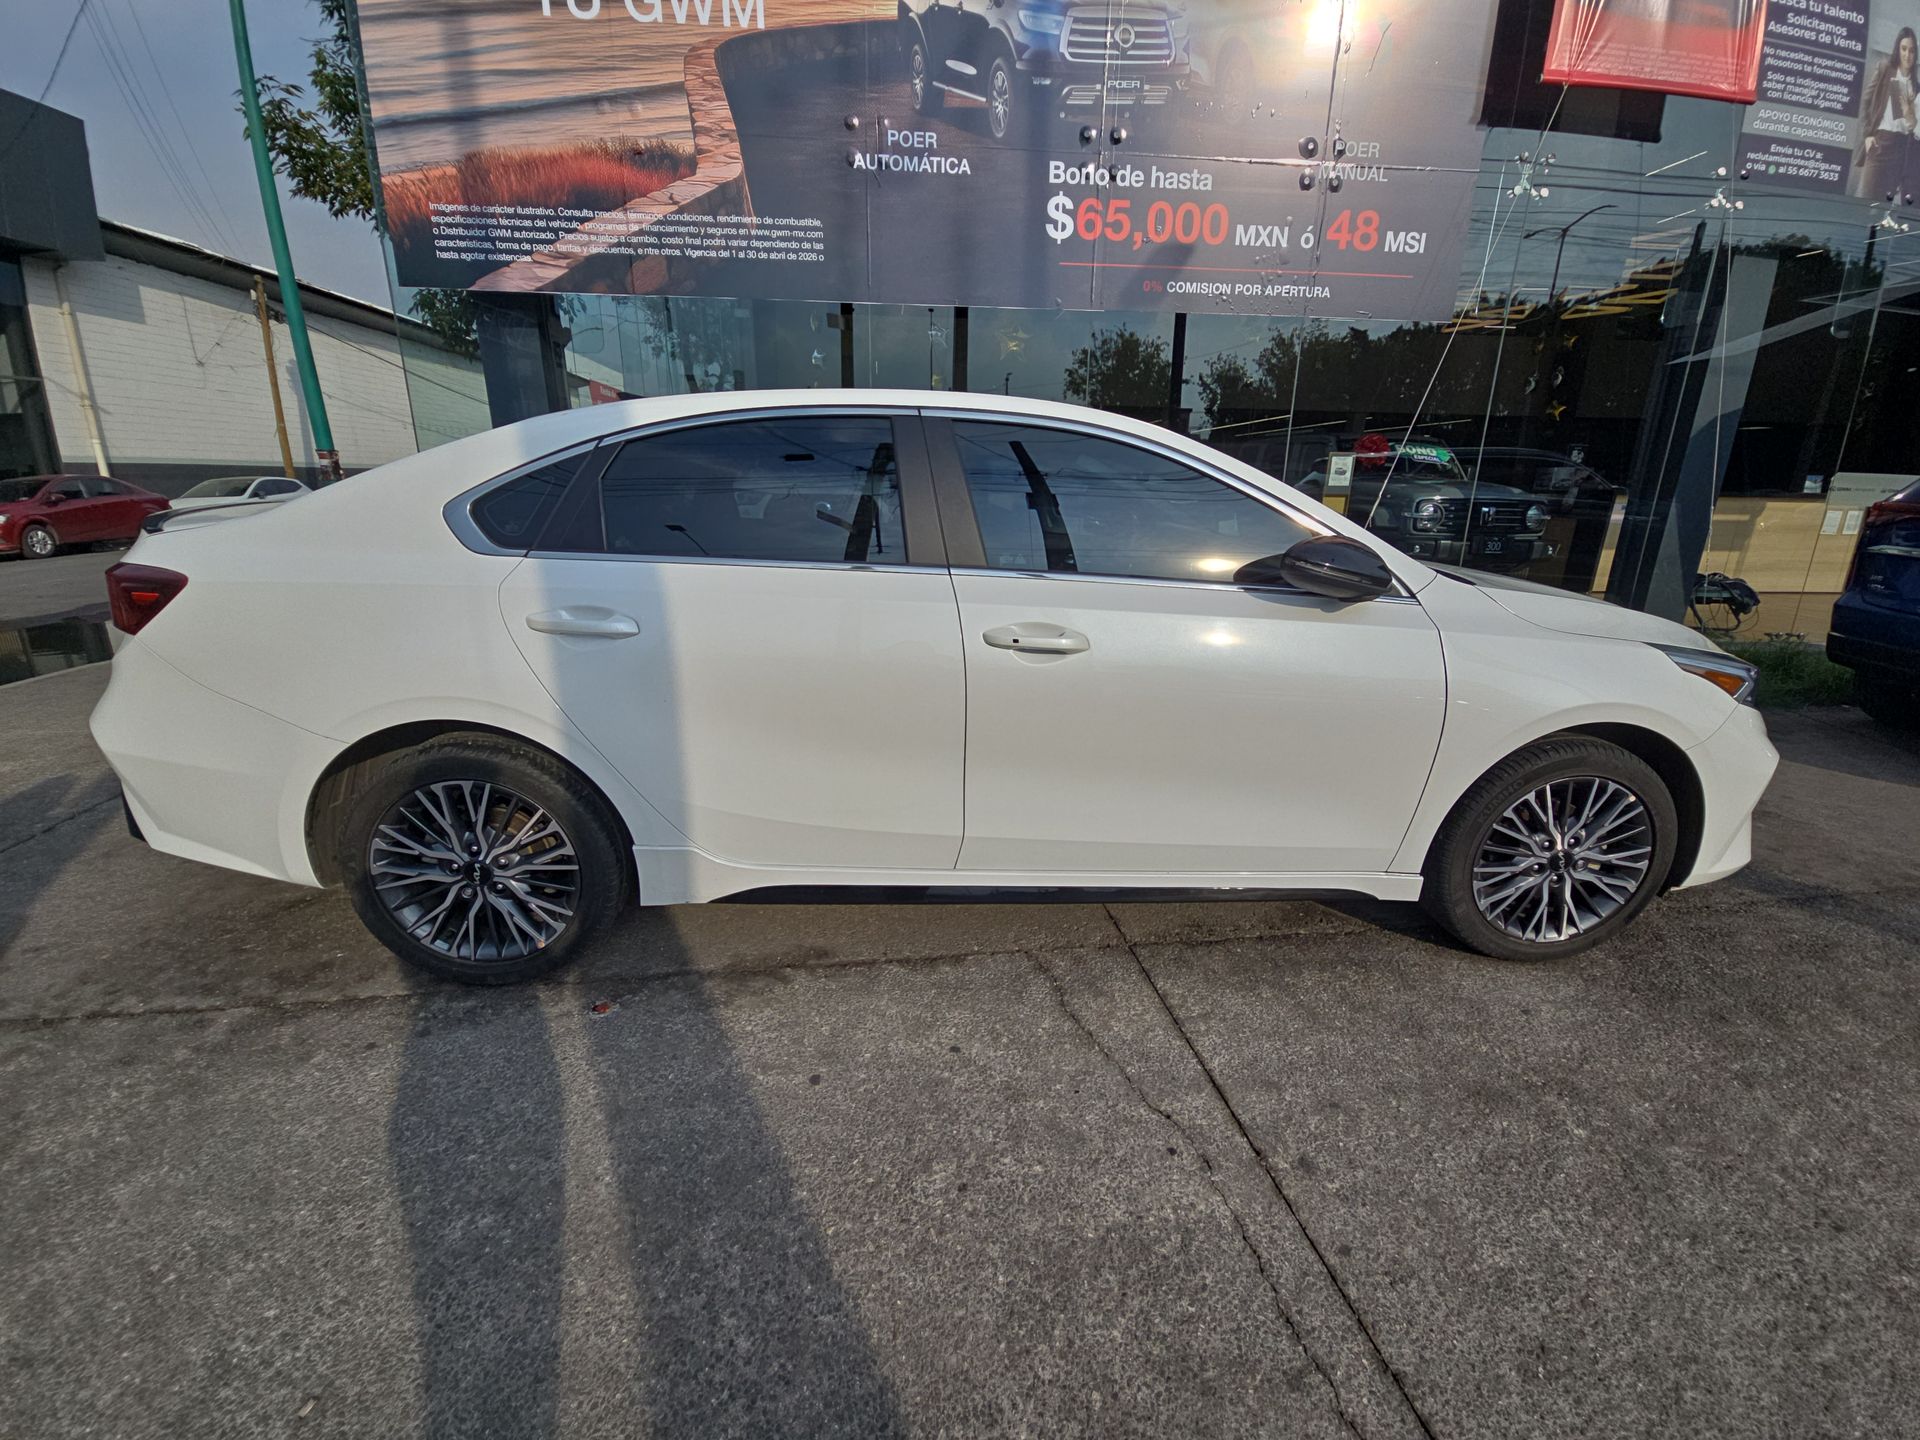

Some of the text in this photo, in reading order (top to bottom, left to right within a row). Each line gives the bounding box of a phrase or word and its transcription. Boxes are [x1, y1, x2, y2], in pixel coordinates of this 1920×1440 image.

[1787, 12, 1847, 36] Solicitamos
[1824, 3, 1864, 24] talento
[1768, 21, 1862, 51] Asesores de Venta
[1763, 46, 1774, 55] No
[1776, 49, 1812, 62] necesitas
[1767, 71, 1848, 94] Solo es indispensable
[1804, 64, 1812, 72] te
[1813, 65, 1854, 81] formamos!
[1762, 80, 1850, 103] saber manejar y contar
[1767, 90, 1782, 98] con
[1783, 90, 1812, 104] licencia
[1753, 120, 1846, 142] durante capacitación
[1758, 109, 1845, 131] APOYO ECONÓMICO
[887, 129, 937, 148] POER
[1335, 140, 1380, 158] POER
[1770, 143, 1792, 154] Envía
[1794, 147, 1802, 156] tu
[1804, 148, 1816, 158] CV
[853, 152, 971, 175] AUTOMÁTICA
[1319, 163, 1388, 182] MANUAL
[1778, 165, 1787, 173] al
[1787, 166, 1797, 175] 55
[1049, 160, 1213, 190] Bono de hasta
[428, 201, 469, 213] Imágenes
[470, 204, 481, 213] de
[482, 204, 515, 214] carácter
[516, 205, 556, 216] ilustrativo.
[558, 207, 593, 218] Consulta
[594, 210, 626, 220] precios,
[667, 212, 715, 223] condiciones,
[717, 214, 761, 224] rendimiento
[763, 216, 773, 225] de
[775, 217, 823, 228] combustible,
[1045, 191, 1426, 254] $65,000 MXN ó 48 MSI
[431, 215, 497, 225] especificaciones
[499, 216, 533, 227] técnicas
[534, 218, 547, 228] del
[585, 222, 627, 232] programas
[628, 223, 639, 231] de
[643, 223, 698, 234] financiamiento
[699, 227, 705, 236] y
[707, 226, 737, 237] seguros
[738, 228, 749, 236] en
[750, 228, 824, 239] www.gwm-mx.com
[432, 227, 439, 235] o
[440, 226, 486, 236] Distribuidor
[488, 228, 512, 238] GWM
[559, 231, 589, 241] Precios
[590, 233, 618, 243] sujetos
[620, 235, 626, 243] a
[661, 236, 684, 245] costo
[685, 236, 701, 245] final
[703, 237, 726, 247] podrá
[727, 238, 748, 247] variar
[750, 239, 799, 249] dependiendo
[801, 240, 811, 249] de
[813, 241, 824, 250] las
[434, 239, 494, 249] características,
[495, 240, 519, 250] forma
[520, 242, 531, 251] de
[532, 243, 555, 253] pago,
[582, 246, 588, 254] y
[589, 244, 636, 255] descuentos,
[684, 247, 717, 258] Vigencia
[718, 249, 730, 257] del
[732, 250, 736, 258] 1
[738, 250, 745, 258] al
[746, 250, 756, 259] 30
[758, 251, 768, 259] de
[769, 251, 785, 260] abril
[787, 252, 797, 260] de
[798, 252, 817, 261] 2026
[818, 254, 824, 262] o
[436, 249, 459, 259] hasta
[460, 251, 486, 262] agotar
[1143, 280, 1330, 298] 0% COMISION POR APERTURA
